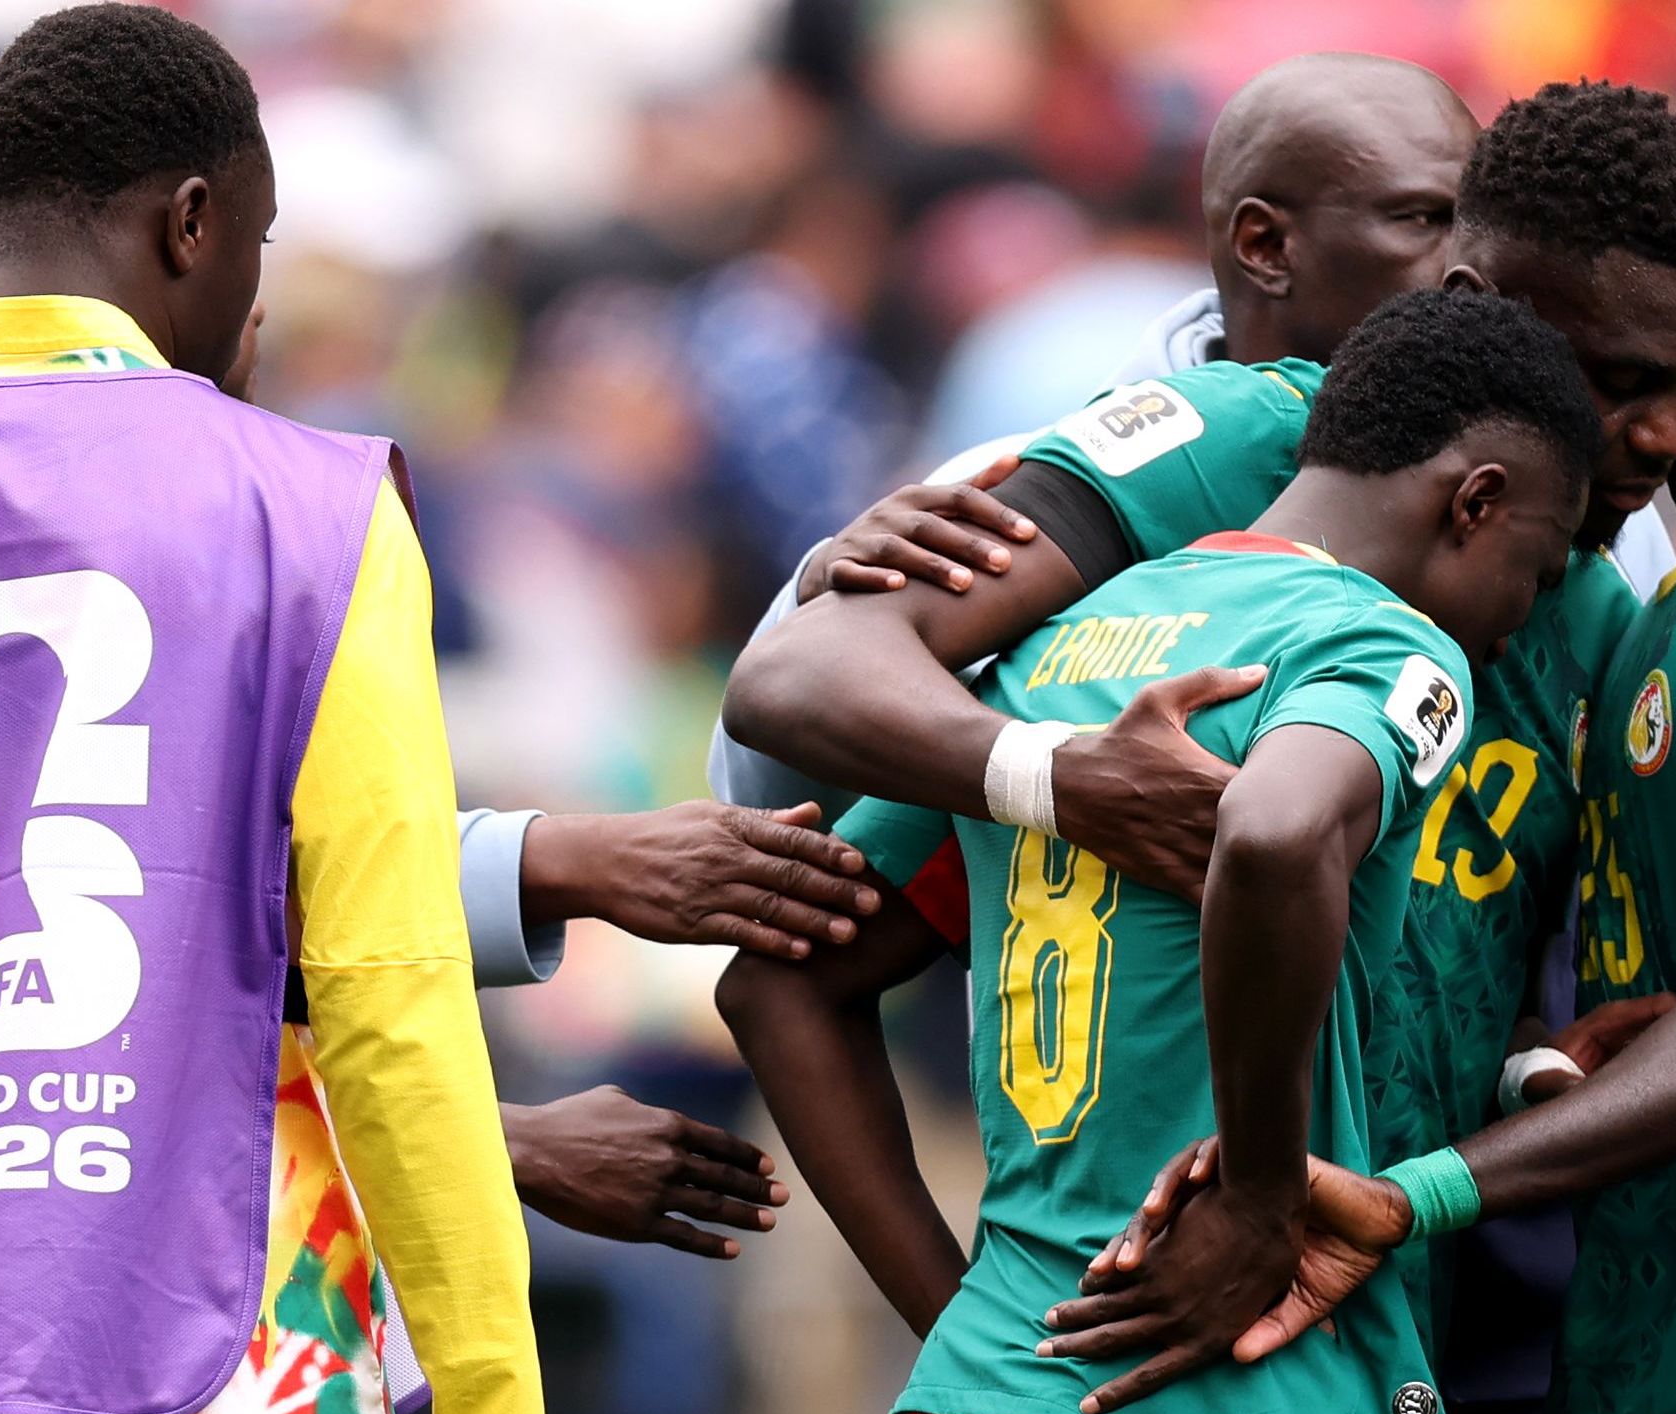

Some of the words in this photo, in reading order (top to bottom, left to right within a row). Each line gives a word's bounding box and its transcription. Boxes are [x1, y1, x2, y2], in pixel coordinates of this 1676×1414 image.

[1026, 611, 1209, 692] LAMINE
[1412, 737, 1540, 902] 19
[997, 723, 1121, 1146] 8
[28, 1071, 137, 1114] CUP
